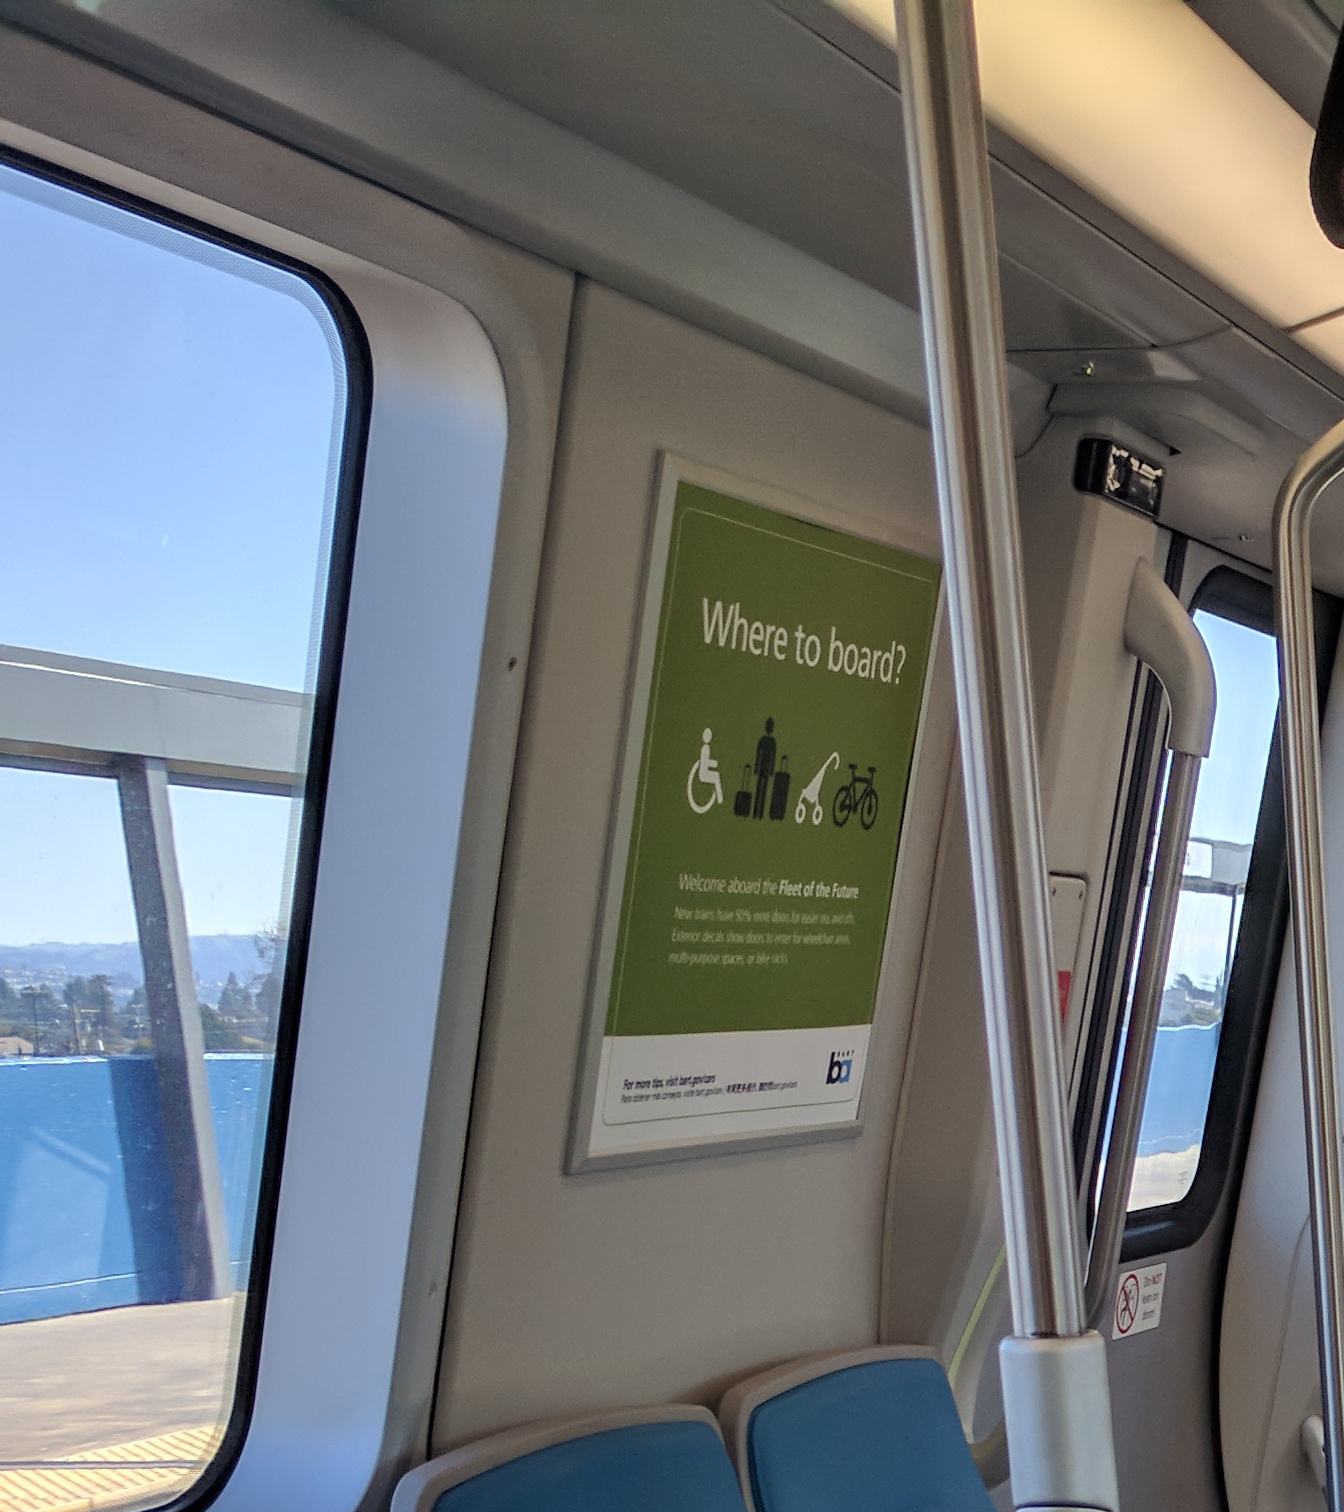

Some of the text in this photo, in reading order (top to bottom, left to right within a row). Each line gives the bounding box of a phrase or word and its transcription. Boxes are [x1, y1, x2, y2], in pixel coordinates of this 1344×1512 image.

[702, 597, 907, 684] Where to board?
[679, 873, 860, 899] Welcome aboard the Fleet of the Future
